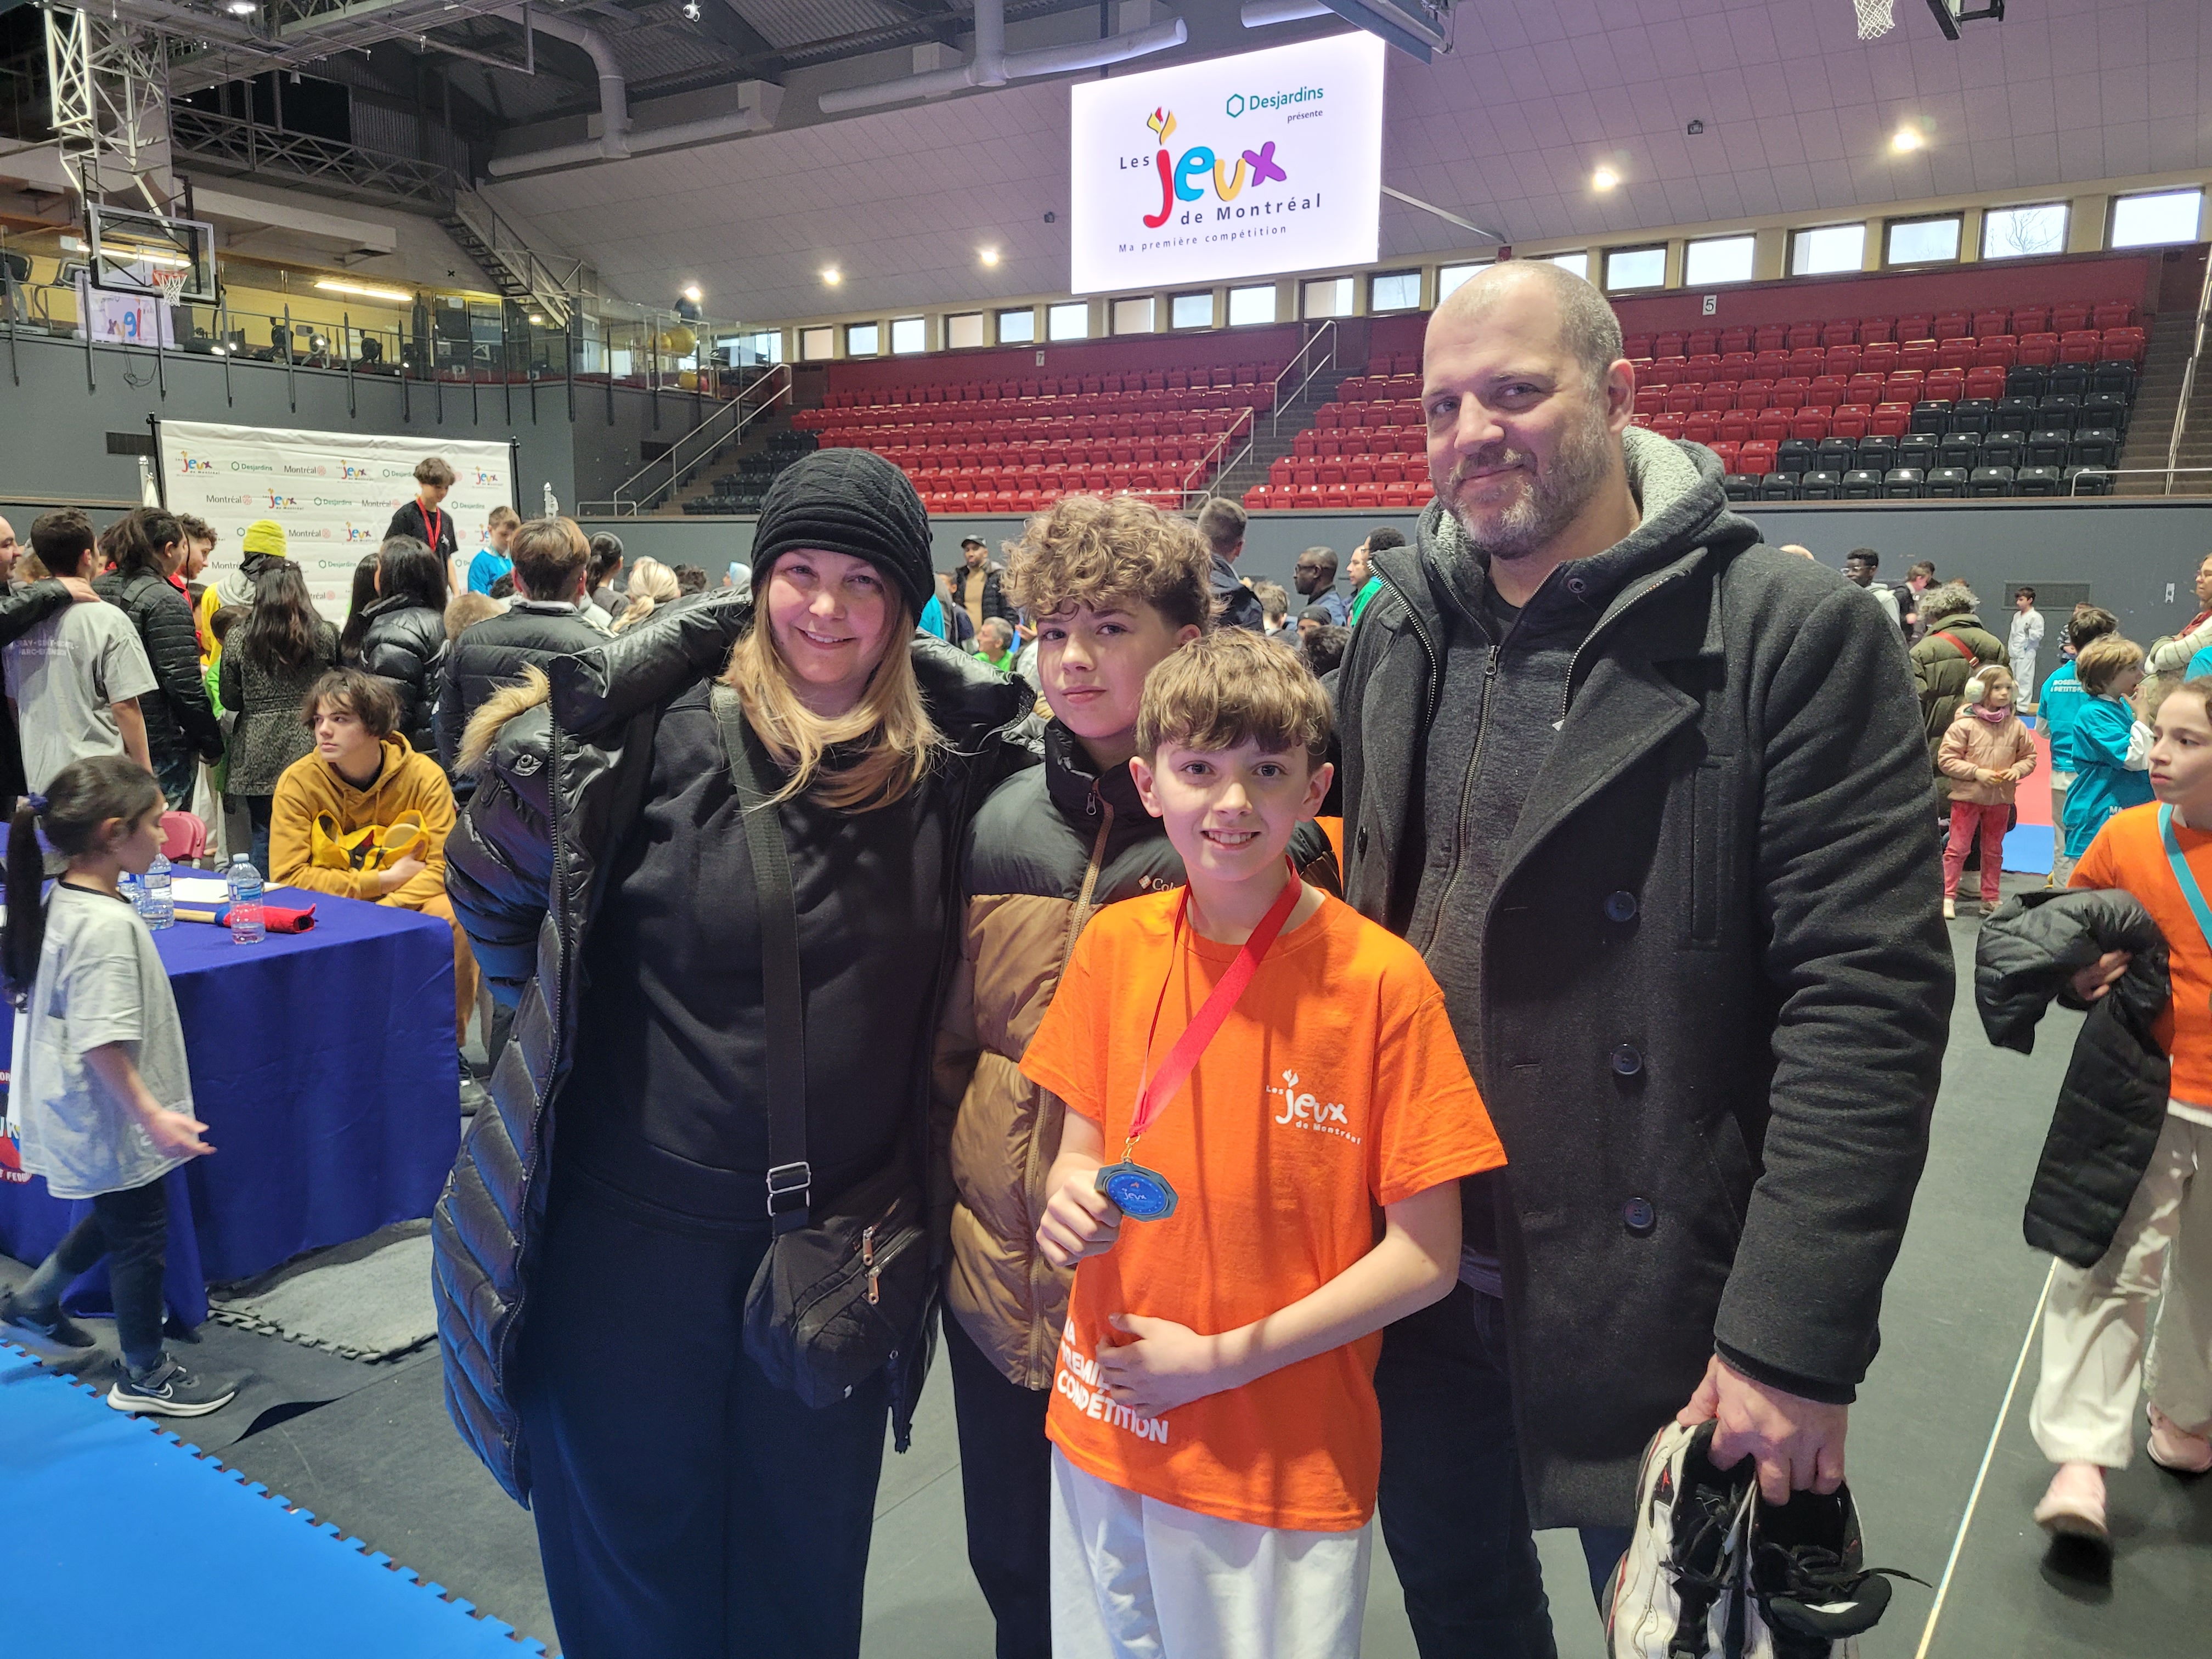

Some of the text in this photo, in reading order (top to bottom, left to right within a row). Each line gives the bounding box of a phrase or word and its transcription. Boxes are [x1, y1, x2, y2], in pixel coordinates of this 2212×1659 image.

[1249, 86, 1324, 110] Desjardins
[1287, 109, 1323, 123] présente
[1120, 155, 1150, 170] Les
[1143, 141, 1287, 228] jeux
[1181, 193, 1321, 225] de Montréal
[1119, 224, 1287, 253] Ma première compétition
[1705, 298, 1714, 312] 5
[1038, 353, 1043, 364] 7
[182, 458, 212, 472] jeux
[241, 463, 273, 471] Desjardins
[284, 465, 317, 474] Montréal
[341, 466, 366, 479] jeux
[206, 495, 241, 504] Montréal
[269, 495, 297, 509] jeux
[479, 530, 489, 542] je
[1266, 1085, 1284, 1095] Les
[1275, 1088, 1348, 1124] jeux
[1295, 1120, 1361, 1145] de Montréal
